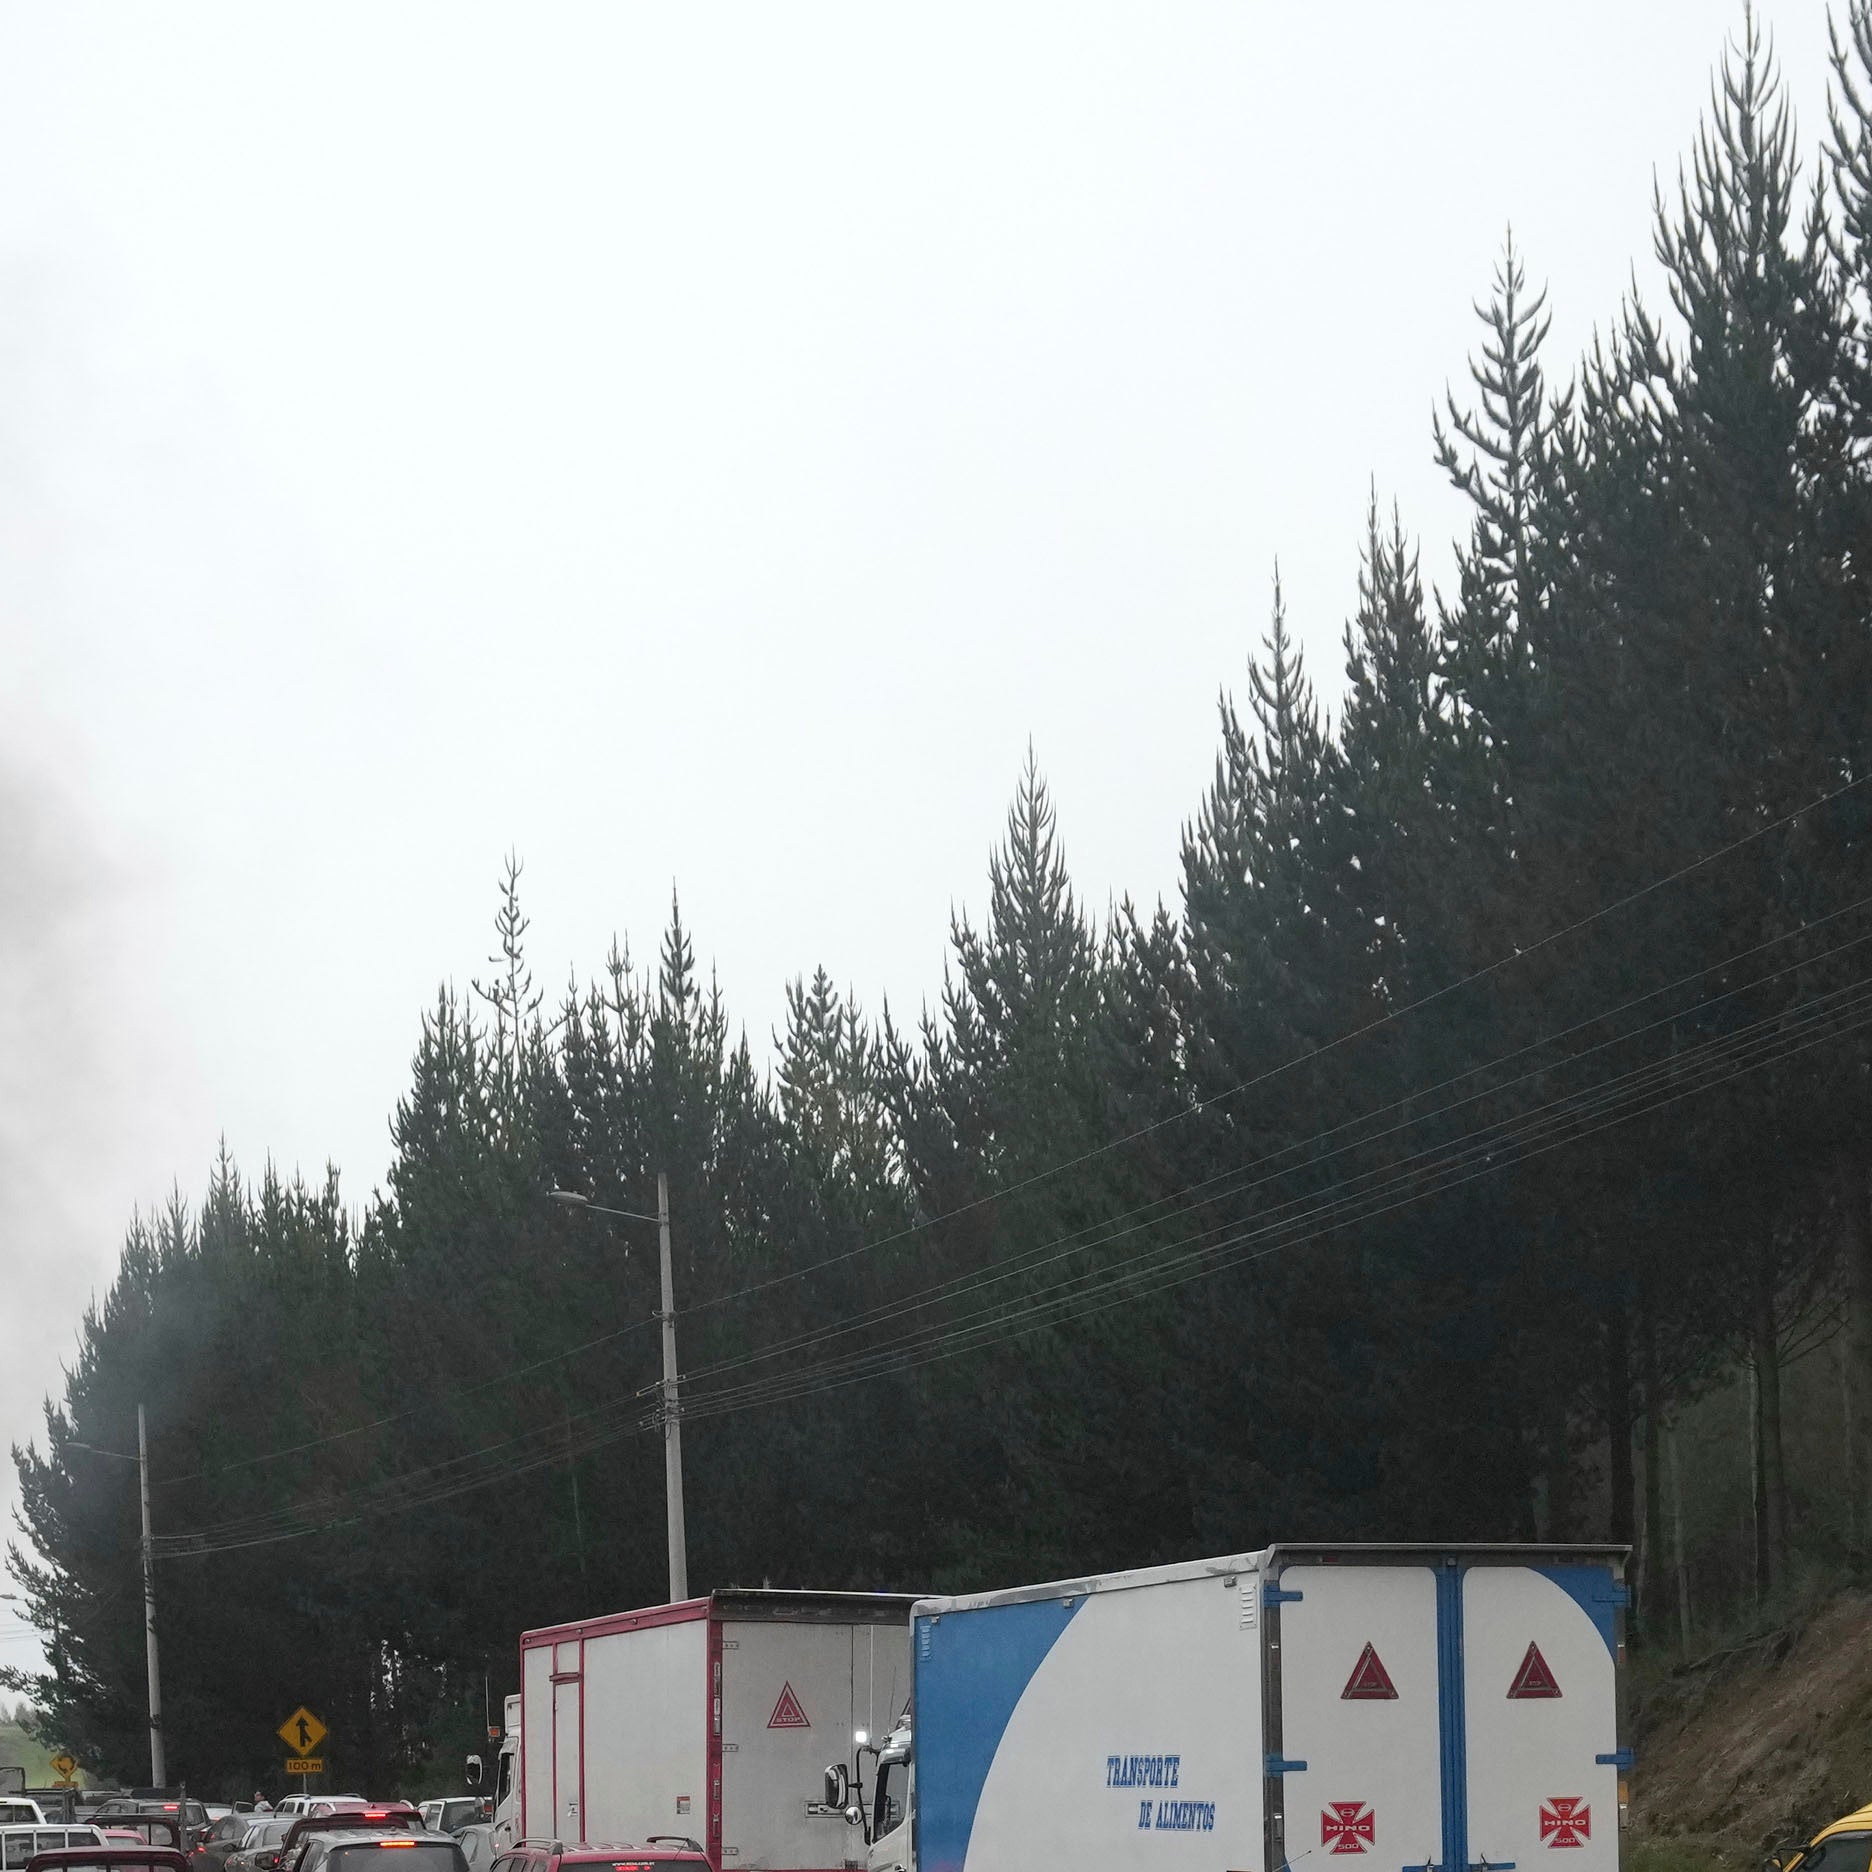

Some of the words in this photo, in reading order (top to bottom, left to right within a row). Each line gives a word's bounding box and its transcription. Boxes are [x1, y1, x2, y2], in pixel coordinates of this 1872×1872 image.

[288, 1761, 309, 1771] 100
[311, 1763, 321, 1771] m
[1106, 1754, 1181, 1789] TRANSPORTE
[1138, 1799, 1153, 1831] DE
[1155, 1799, 1216, 1832] ALIMENTOS
